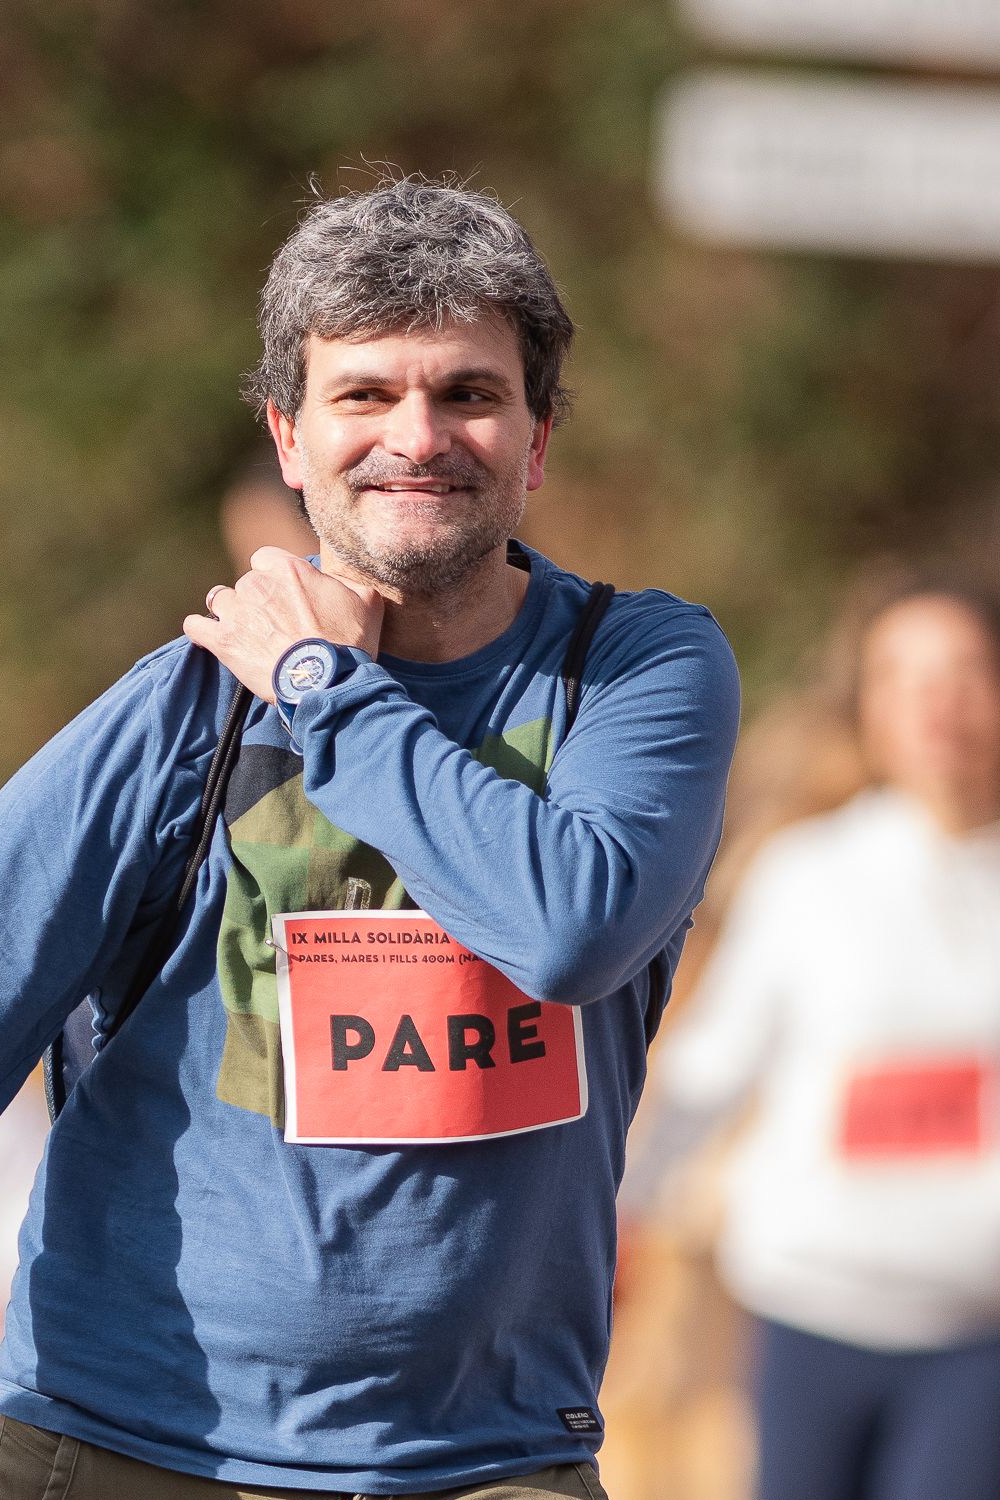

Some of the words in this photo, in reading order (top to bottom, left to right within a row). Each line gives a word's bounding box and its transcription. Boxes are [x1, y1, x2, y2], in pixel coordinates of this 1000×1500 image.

[292, 932, 308, 945] IX
[314, 932, 362, 944] MILLA
[367, 929, 451, 945] SOLIDÀRIA
[299, 954, 338, 964] PARES,
[342, 954, 379, 963] MARES
[382, 954, 387, 963] I
[390, 954, 418, 963] FILLS
[422, 954, 455, 964] 400M
[330, 1001, 546, 1073] PARE
